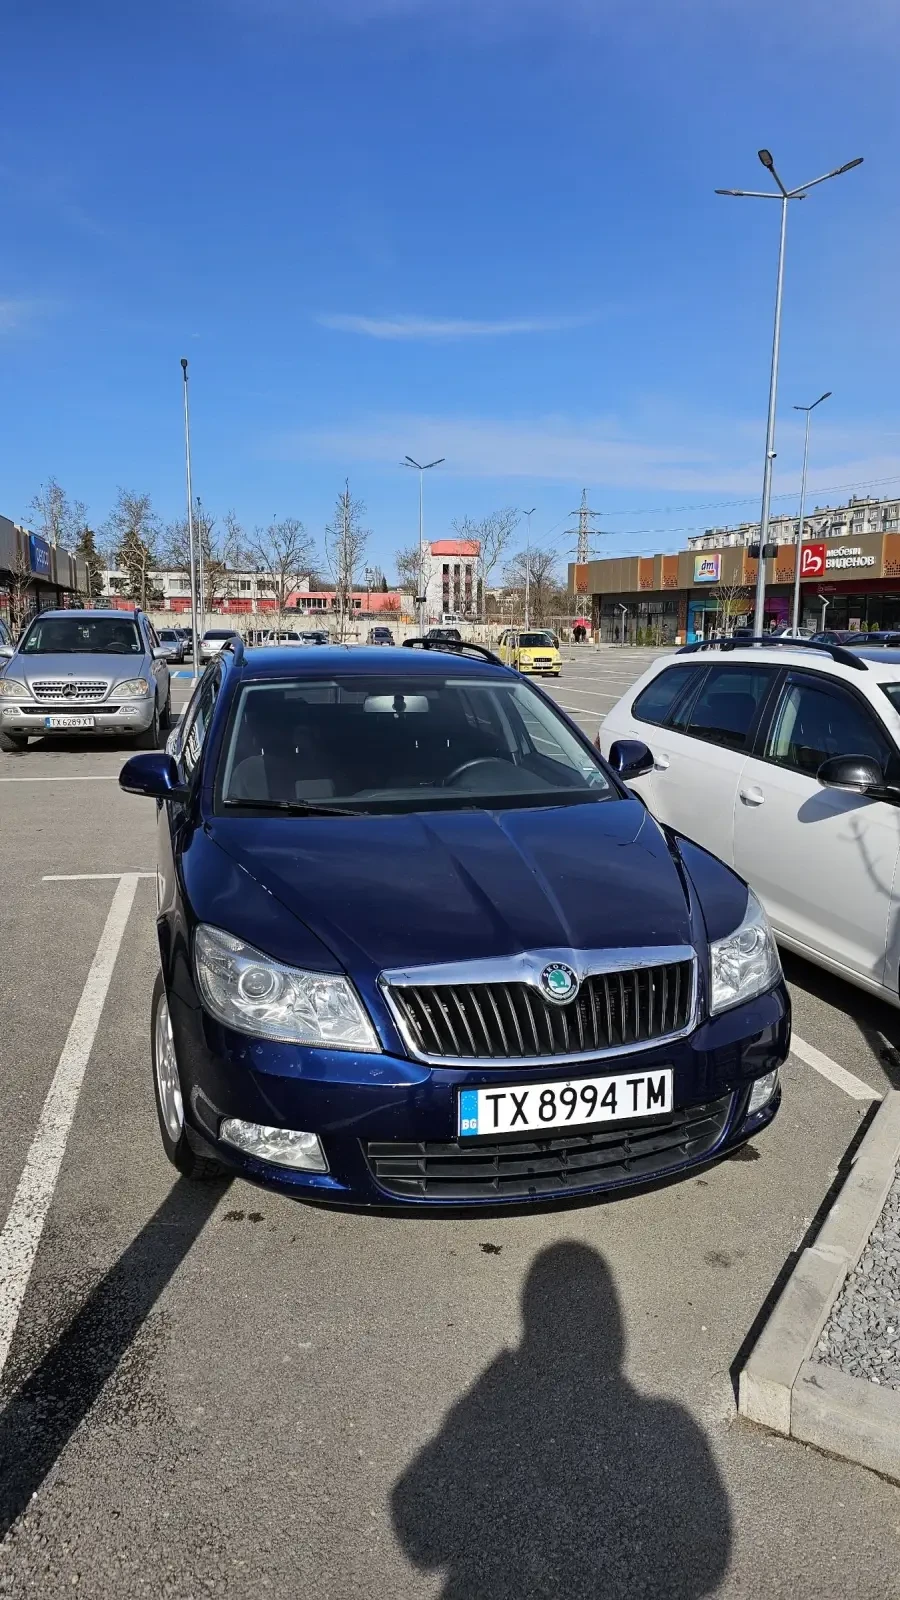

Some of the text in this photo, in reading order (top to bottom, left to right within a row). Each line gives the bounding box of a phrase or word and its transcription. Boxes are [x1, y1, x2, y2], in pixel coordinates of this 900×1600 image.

[701, 559, 714, 571] dm
[51, 718, 61, 726] TX
[63, 718, 81, 726] 6289
[82, 717, 93, 726] XT
[485, 1075, 666, 1127] TX 8994 TM
[461, 1118, 477, 1130] BG
